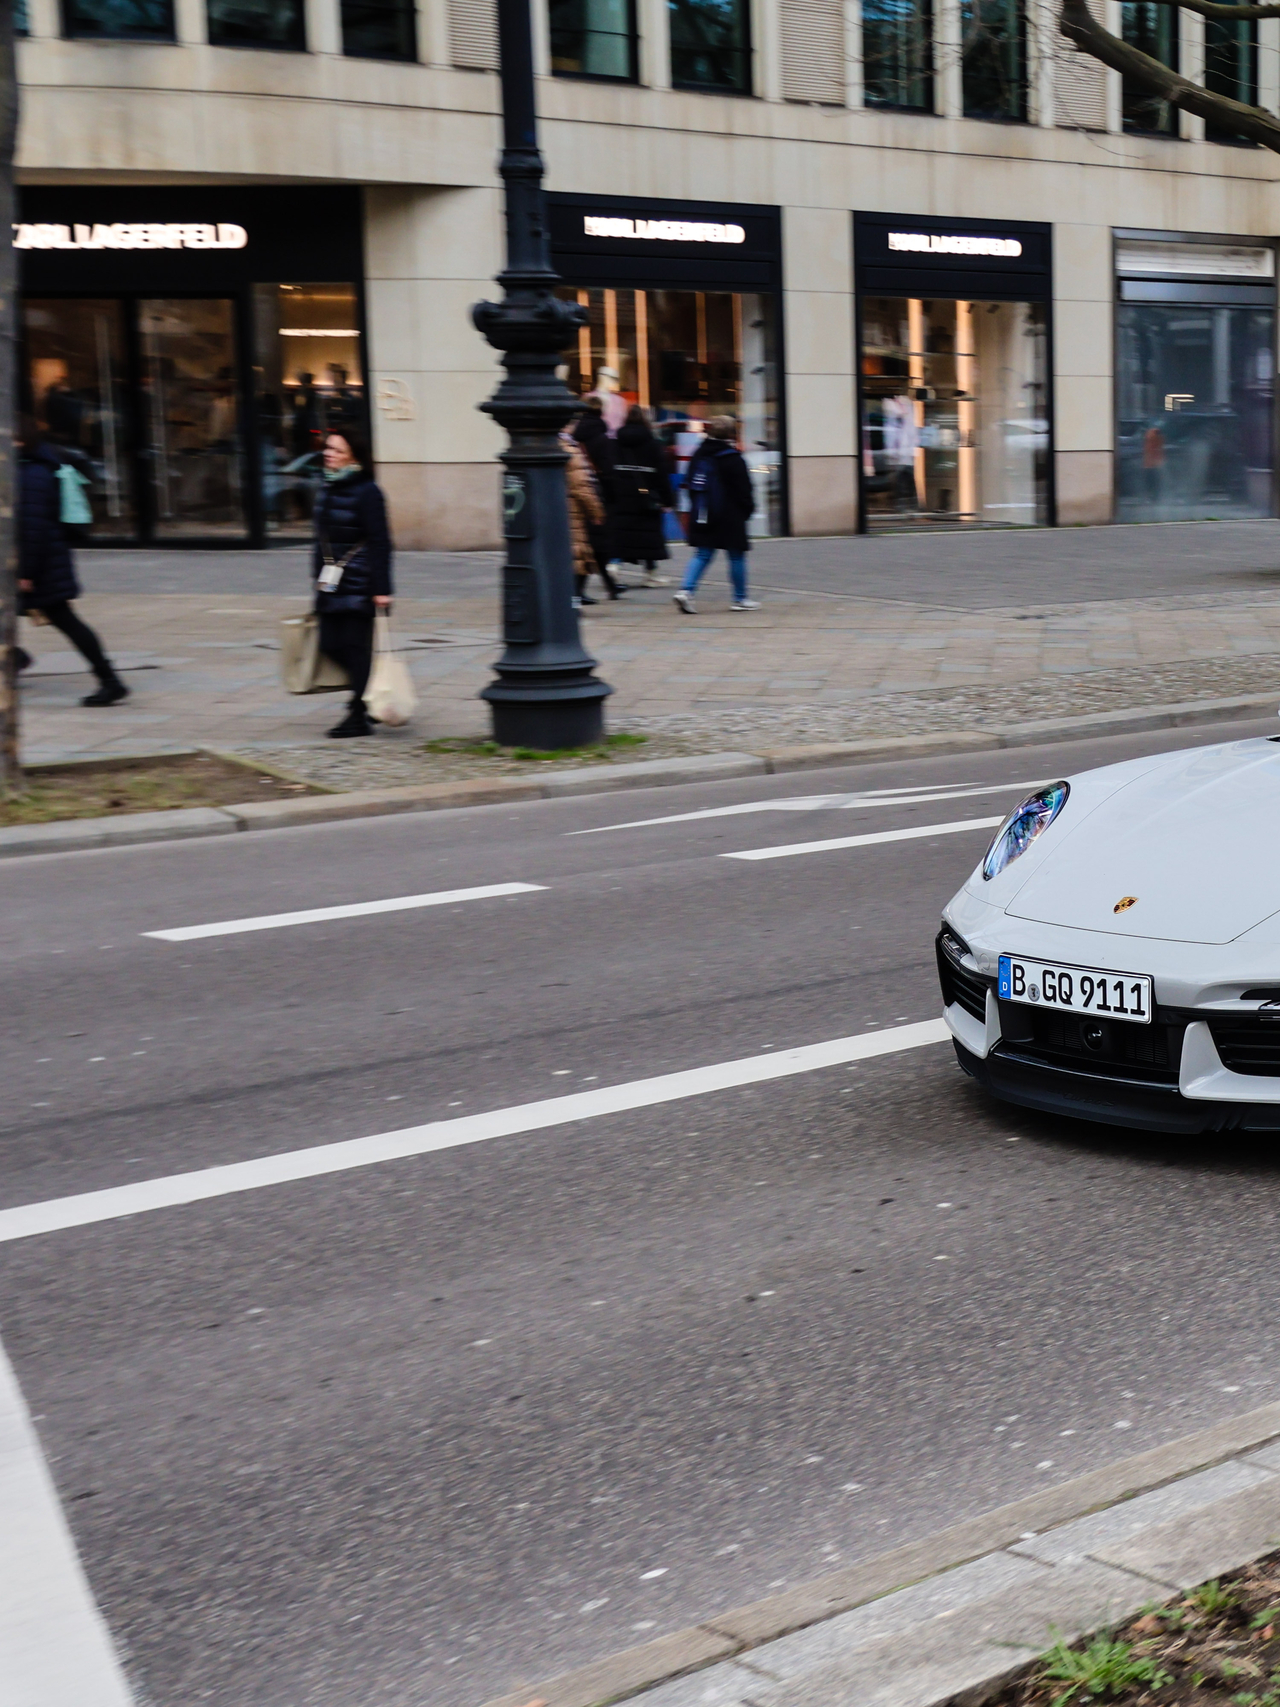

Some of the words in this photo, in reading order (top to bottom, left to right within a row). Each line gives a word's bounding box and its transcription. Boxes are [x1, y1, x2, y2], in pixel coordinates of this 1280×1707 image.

[72, 223, 248, 249] LAGERFELD
[1002, 981, 1008, 992] D
[1012, 963, 1026, 997] B
[1042, 969, 1074, 1006] GQ
[1080, 975, 1146, 1017] 9111
